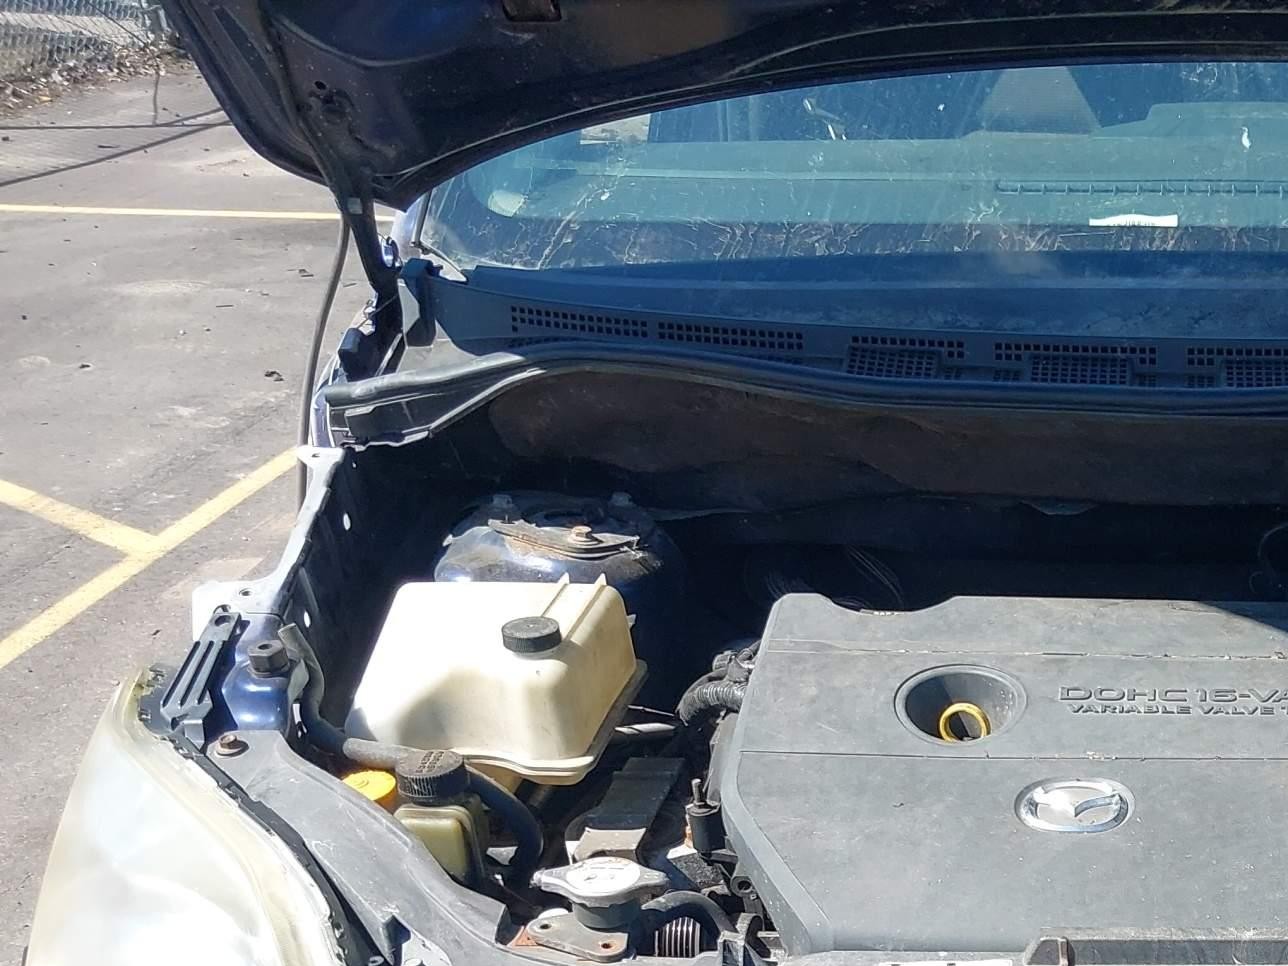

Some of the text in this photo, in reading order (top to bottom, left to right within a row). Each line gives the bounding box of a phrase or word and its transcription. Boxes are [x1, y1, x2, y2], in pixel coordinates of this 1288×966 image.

[1059, 686, 1189, 702] DOHC
[1069, 703, 1192, 715] VARIABLE
[1199, 704, 1276, 715] VALVE
